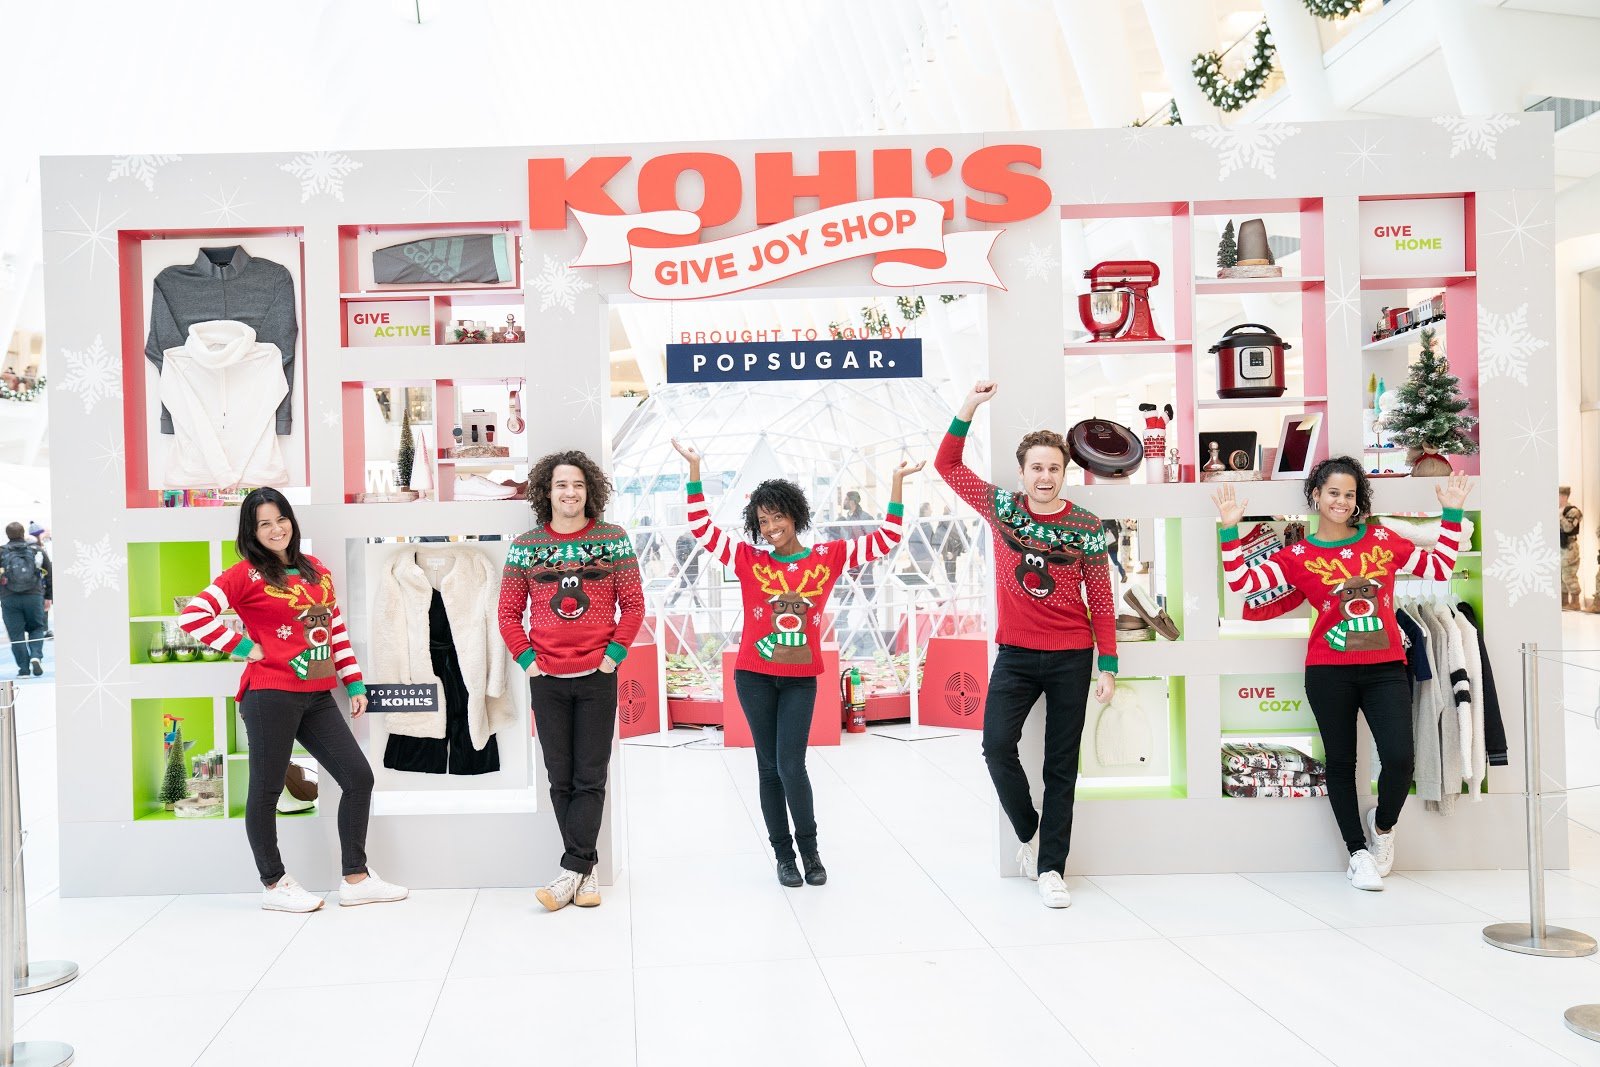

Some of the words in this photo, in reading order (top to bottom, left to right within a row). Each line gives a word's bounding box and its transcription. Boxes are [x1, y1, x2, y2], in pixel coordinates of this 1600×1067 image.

[527, 144, 1053, 231] KOHL'S
[1374, 225, 1412, 238] GIVE
[654, 252, 739, 287] GIVE
[748, 228, 810, 272] JOY
[820, 209, 917, 248] SHOP
[1394, 237, 1443, 251] HOME
[353, 312, 390, 325] GIVE
[374, 325, 431, 338] ACTIVE
[681, 329, 782, 345] BROUGHT
[791, 328, 818, 343] TO
[828, 326, 871, 341] YOU
[881, 326, 908, 340] BY
[693, 350, 896, 373] POPSUGAR.
[370, 688, 432, 697] POPSUGAR
[1238, 687, 1276, 699] GIVE
[381, 697, 433, 707] KOHL'S
[1258, 699, 1302, 712] COZY
